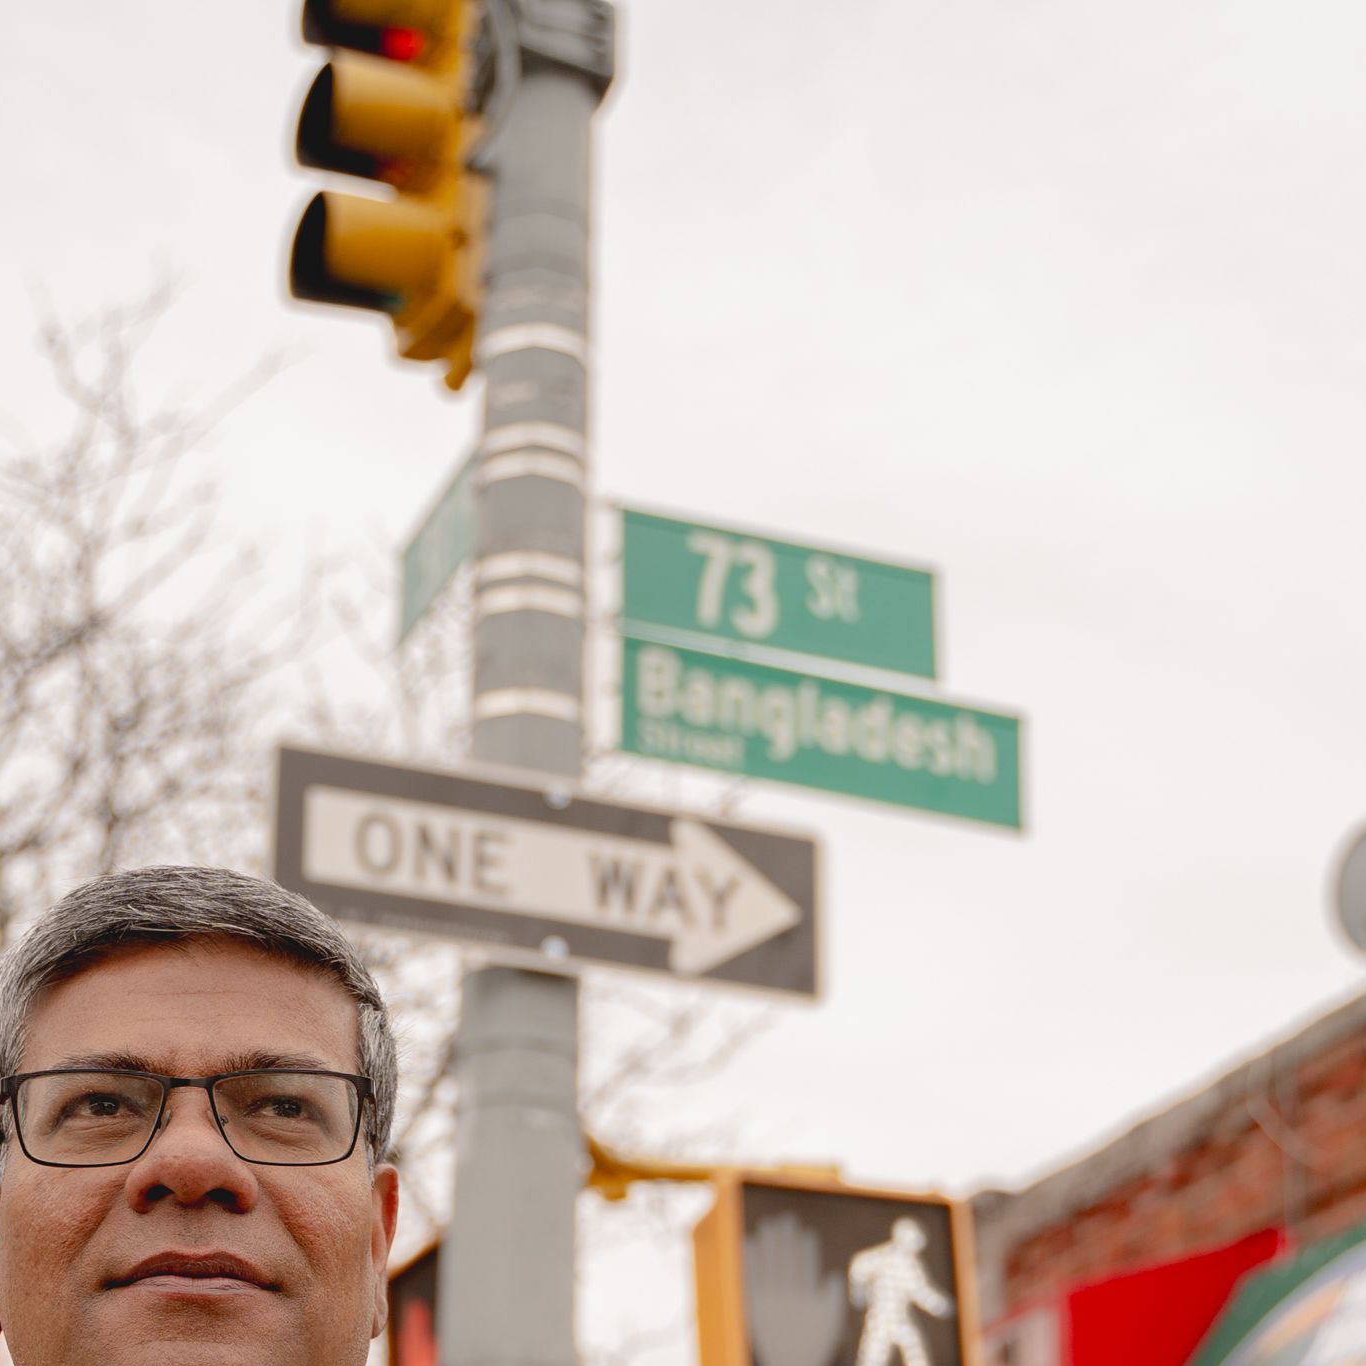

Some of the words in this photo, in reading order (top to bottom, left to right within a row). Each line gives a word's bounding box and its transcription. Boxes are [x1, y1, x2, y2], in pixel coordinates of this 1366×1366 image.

[686, 532, 781, 640] 73
[636, 645, 1000, 787] Bangladesh
[352, 809, 511, 897] ONE
[587, 846, 741, 934] WAY
